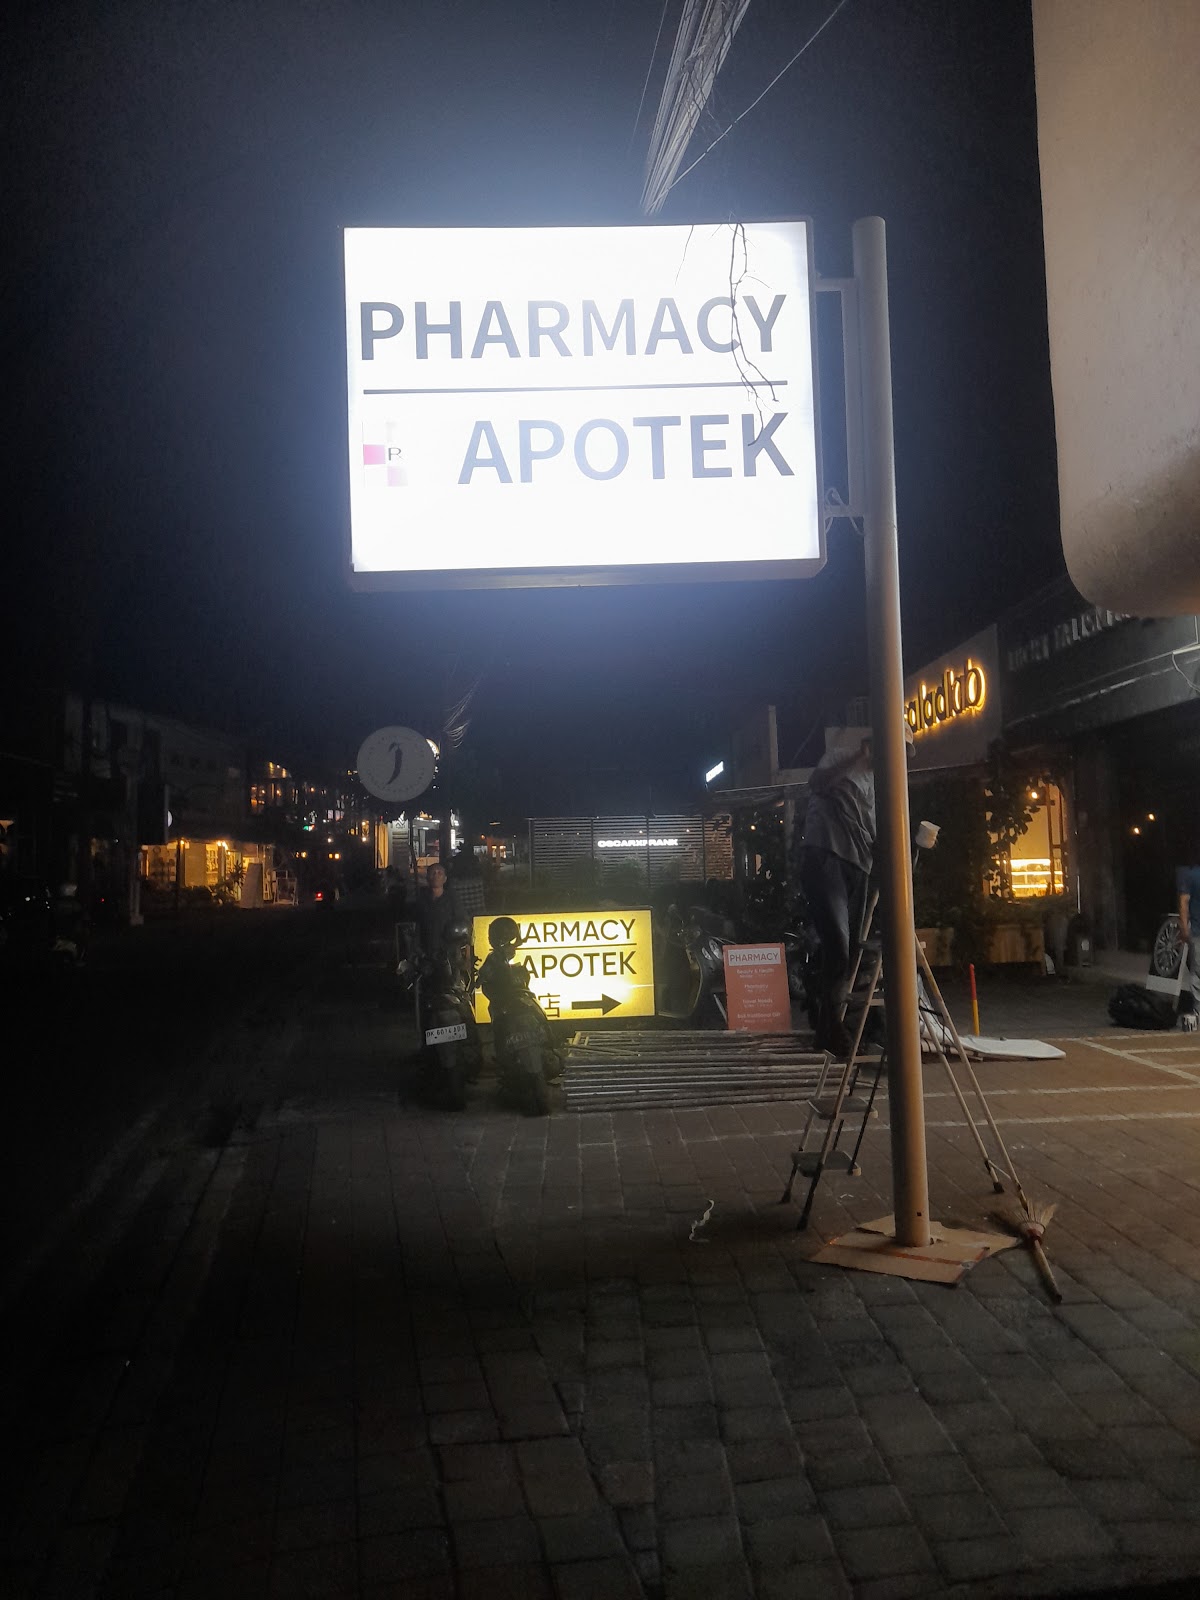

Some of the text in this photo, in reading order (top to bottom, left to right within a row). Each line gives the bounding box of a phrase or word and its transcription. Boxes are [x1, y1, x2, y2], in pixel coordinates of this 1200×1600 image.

[360, 294, 787, 360] PHARMACY
[457, 412, 795, 485] APOTEK
[904, 658, 985, 733] aladlab
[489, 918, 636, 943] ARMACY
[522, 950, 637, 978] APOTEK
[729, 953, 778, 962] PHARMACY
